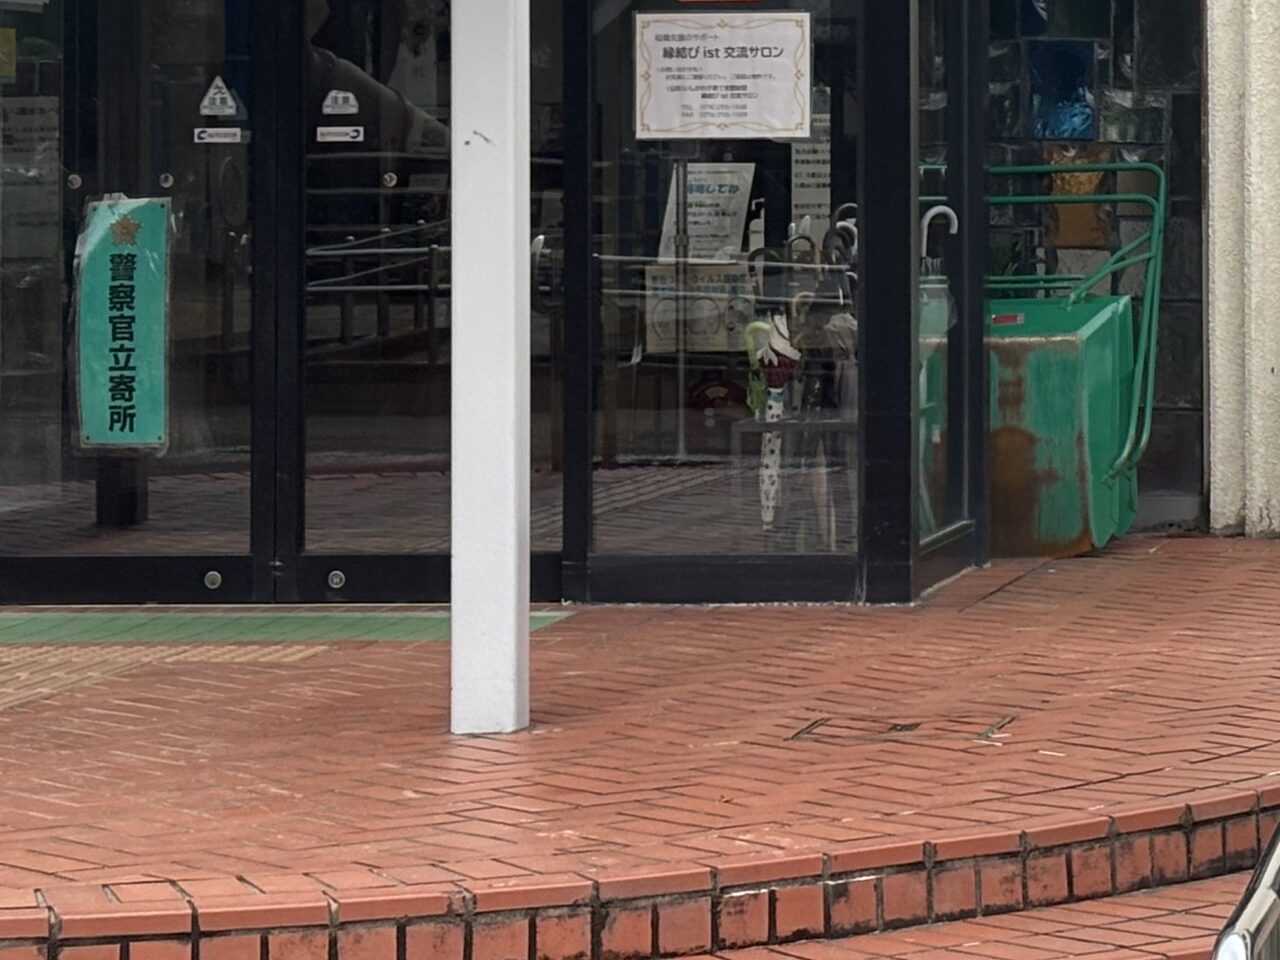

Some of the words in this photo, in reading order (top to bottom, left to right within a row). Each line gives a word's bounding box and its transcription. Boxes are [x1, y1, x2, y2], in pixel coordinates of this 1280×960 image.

[662, 46, 700, 59] 縁結び
[703, 46, 721, 59] ist
[724, 46, 784, 59] 交流サロン
[108, 253, 137, 433] 警察官立寄所
